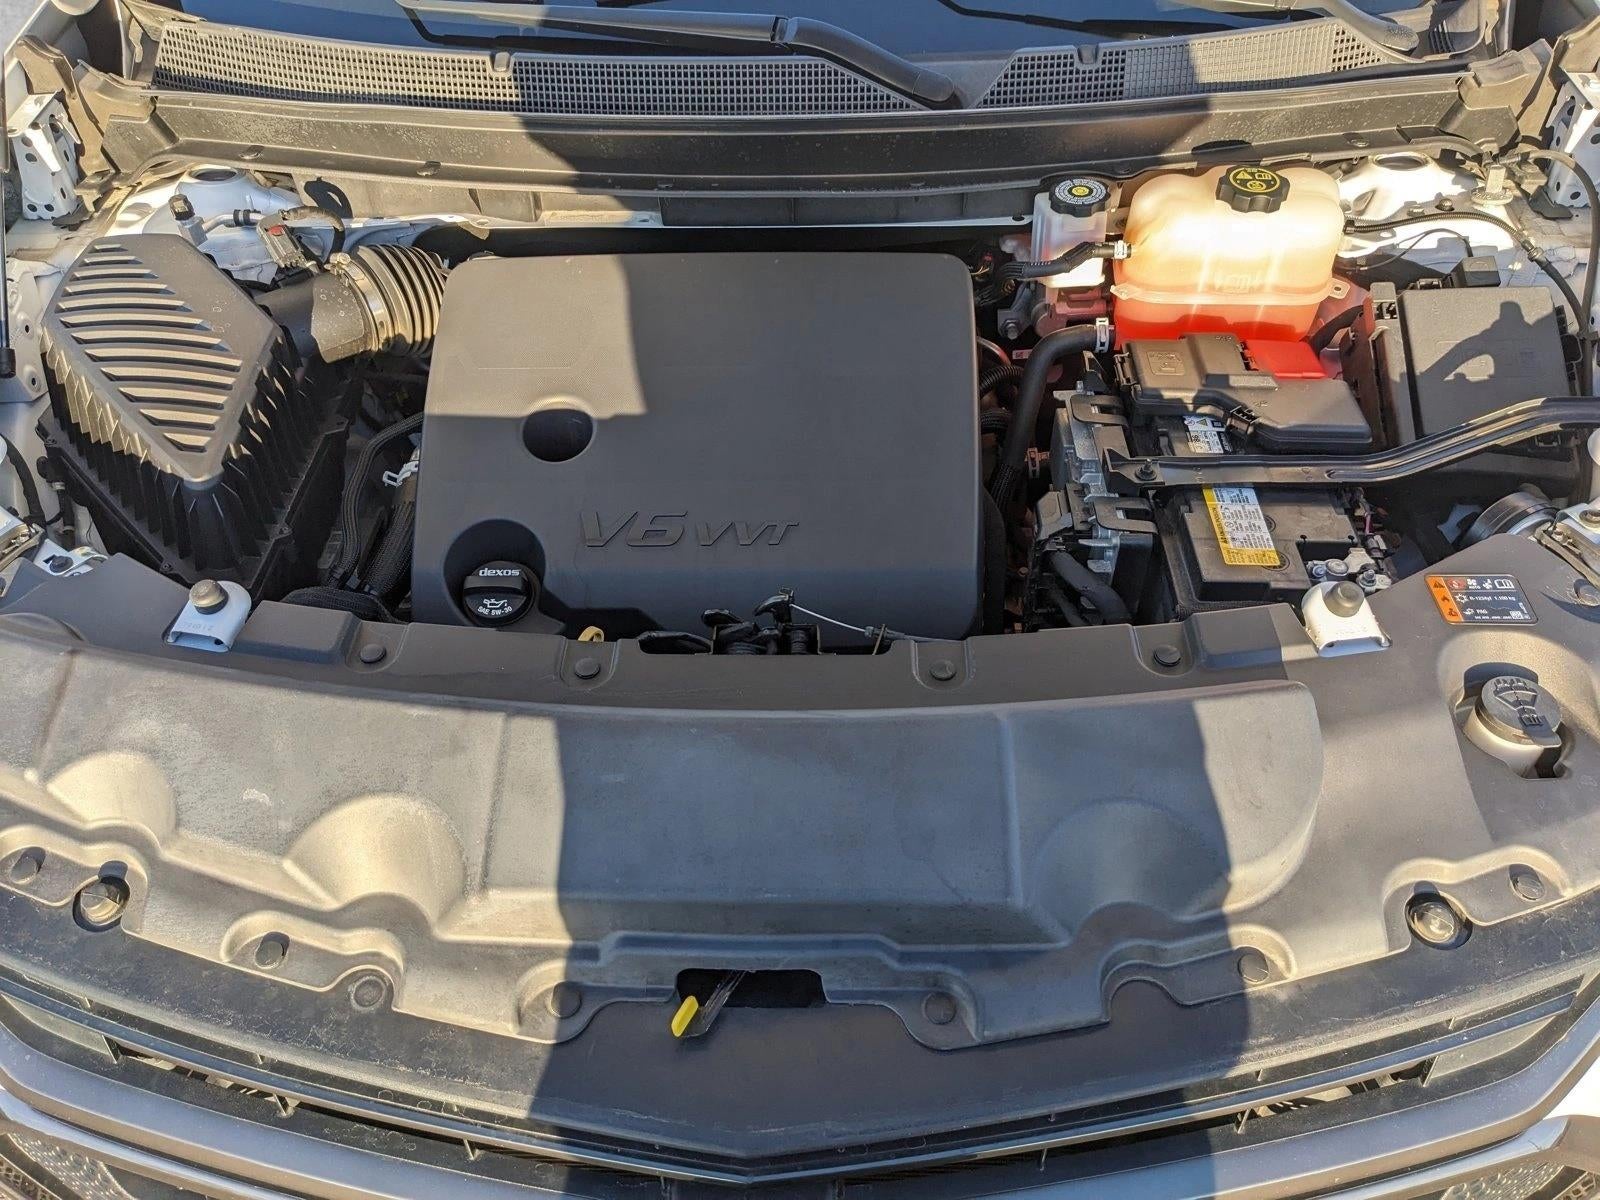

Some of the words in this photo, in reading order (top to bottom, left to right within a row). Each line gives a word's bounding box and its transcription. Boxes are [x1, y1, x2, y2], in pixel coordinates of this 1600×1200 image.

[579, 511, 688, 547] V6
[696, 521, 800, 546] VVT
[479, 568, 521, 577] dexos
[477, 606, 490, 615] SAE
[491, 605, 513, 616] 5W-30
